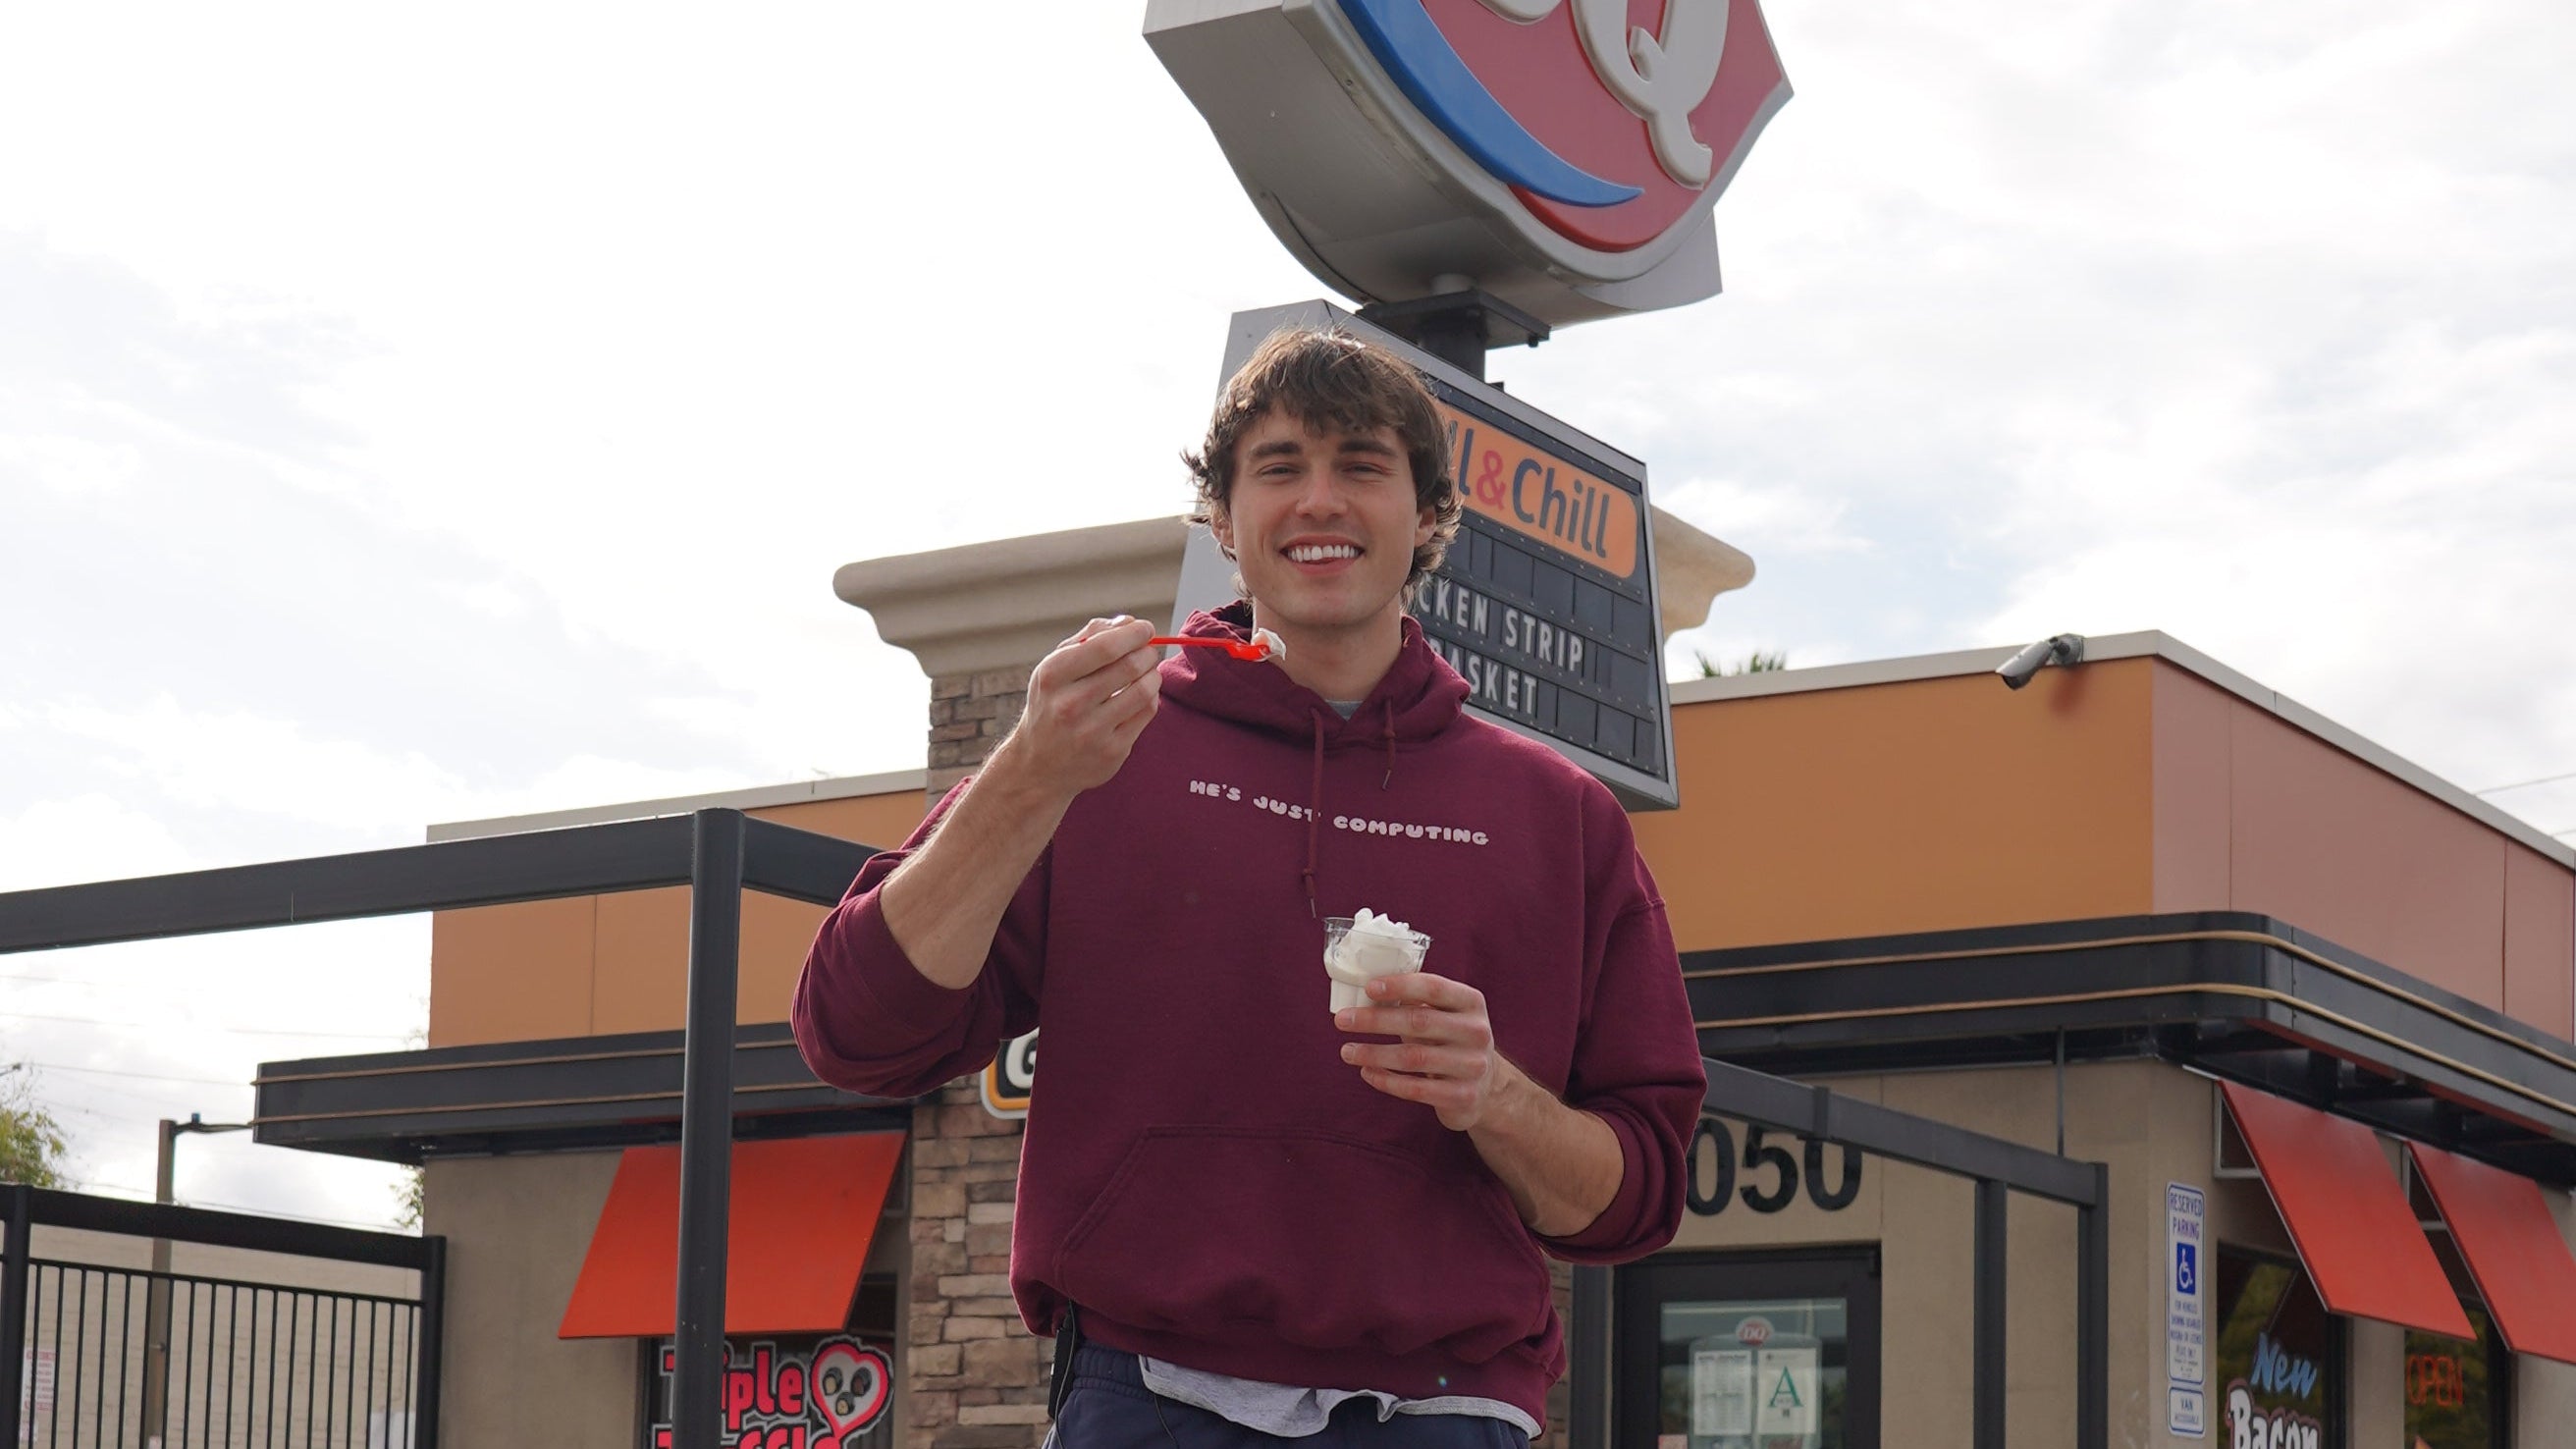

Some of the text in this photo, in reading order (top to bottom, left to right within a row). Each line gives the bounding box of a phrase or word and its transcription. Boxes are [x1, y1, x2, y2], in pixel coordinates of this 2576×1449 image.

[1504, 612, 1584, 672] STRIP
[1189, 779, 1242, 801] HE'S
[1333, 816, 1489, 845] COMPUTING
[2170, 1192, 2203, 1217] RESERVED
[2173, 1216, 2200, 1241] PARKING
[1769, 1366, 1803, 1408] A
[2250, 1332, 2318, 1399] New
[2407, 1354, 2463, 1407] OPEN
